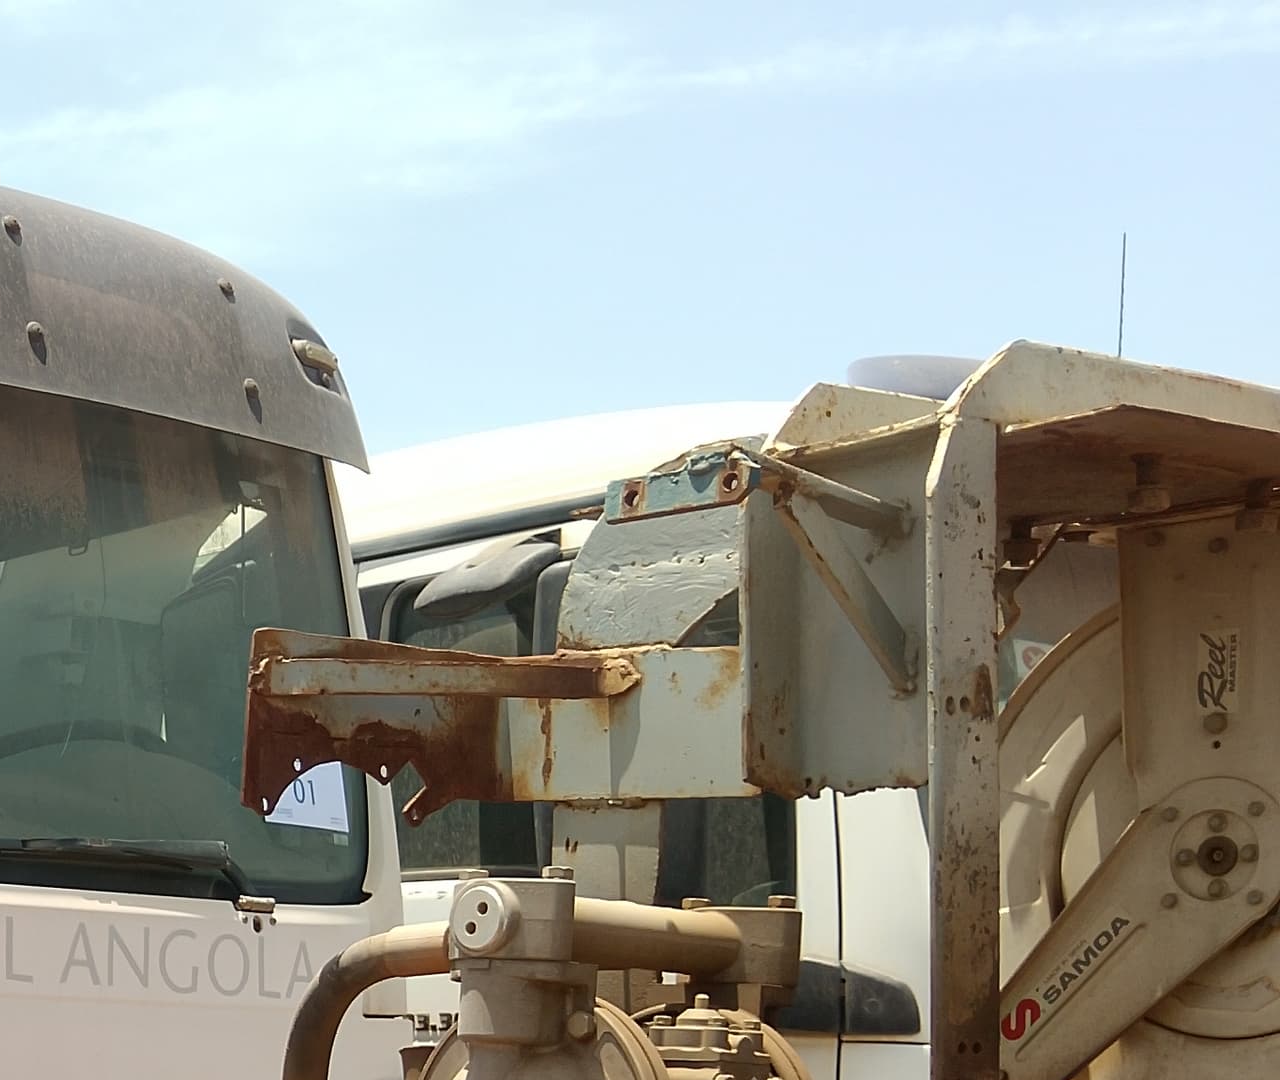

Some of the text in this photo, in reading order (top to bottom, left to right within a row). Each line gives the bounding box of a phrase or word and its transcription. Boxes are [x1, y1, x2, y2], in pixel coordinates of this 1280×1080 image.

[1197, 632, 1228, 712] Reel
[59, 920, 314, 1000] ANGOLA
[1042, 916, 1131, 1005] SAMOA
